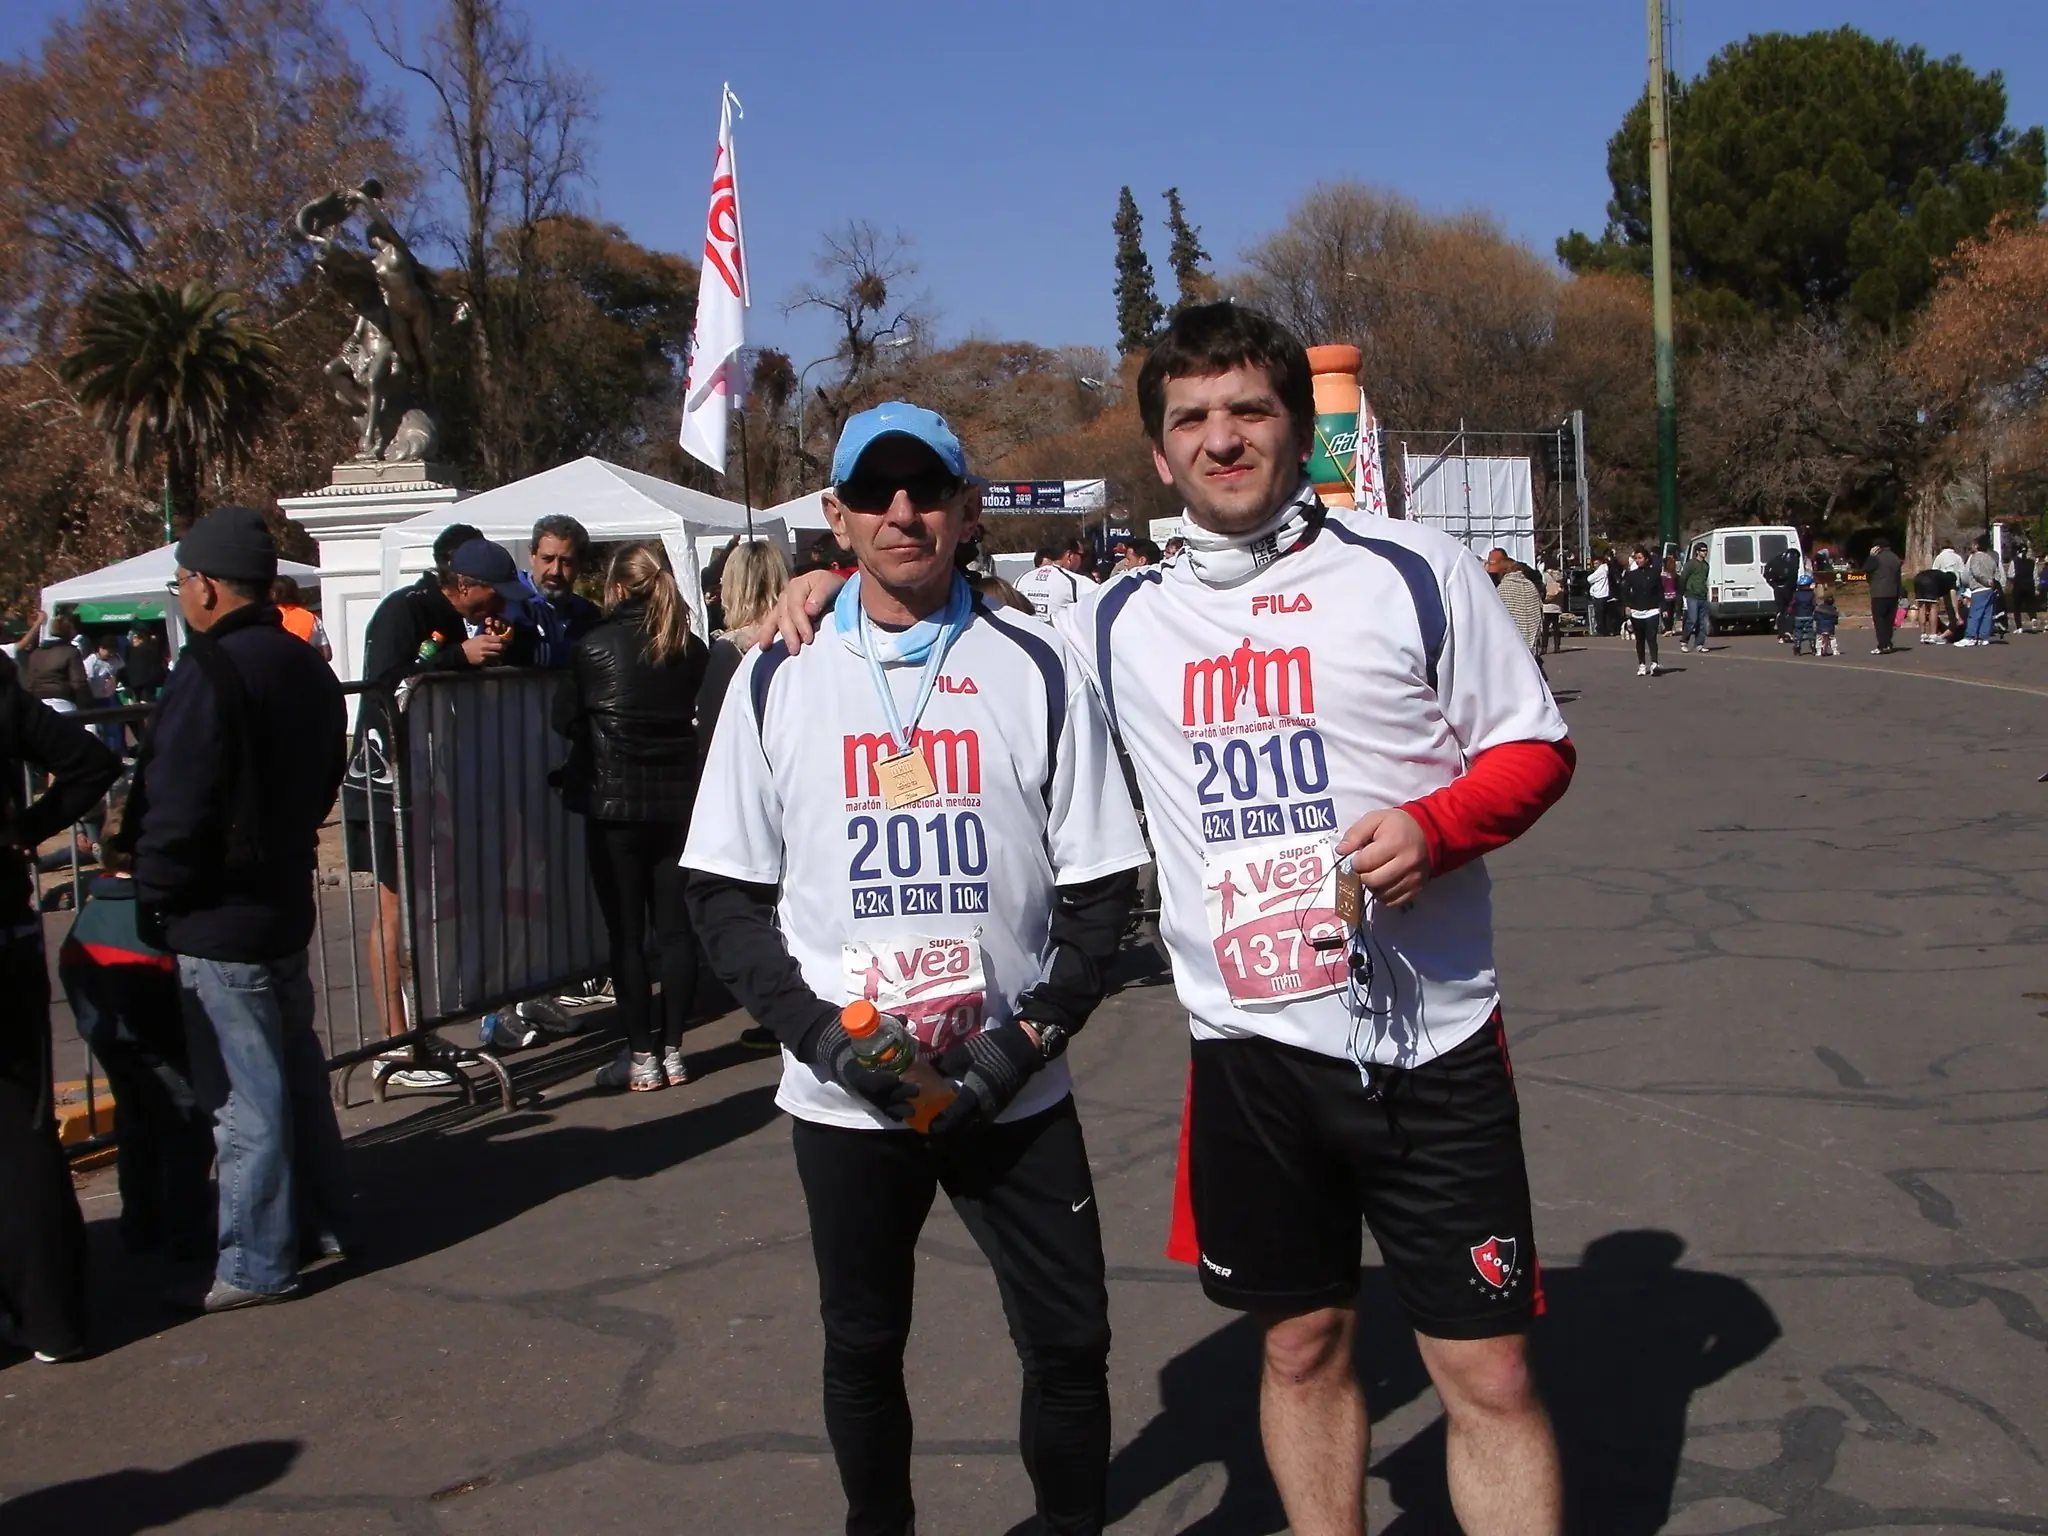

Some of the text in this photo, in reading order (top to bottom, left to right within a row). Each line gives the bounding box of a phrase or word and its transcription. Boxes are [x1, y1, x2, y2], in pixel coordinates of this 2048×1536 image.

[1325, 431, 1359, 457] Gat
[981, 494, 1010, 507] ndoza
[1110, 528, 1131, 537] FILA
[1847, 573, 1867, 581] Rosed
[1252, 593, 1313, 616] FILA
[938, 675, 979, 694] ILA
[1183, 716, 1317, 739] maratón internacional mendoza
[1193, 730, 1330, 806] 2010
[845, 799, 882, 812] maratón
[945, 797, 982, 808] mendoza
[1204, 804, 1332, 839] 42K 21K 10K
[847, 811, 989, 881] 2010
[1279, 844, 1319, 860] super
[855, 886, 985, 915] 42K 21K 10K
[1202, 1253, 1232, 1278] OPPER
